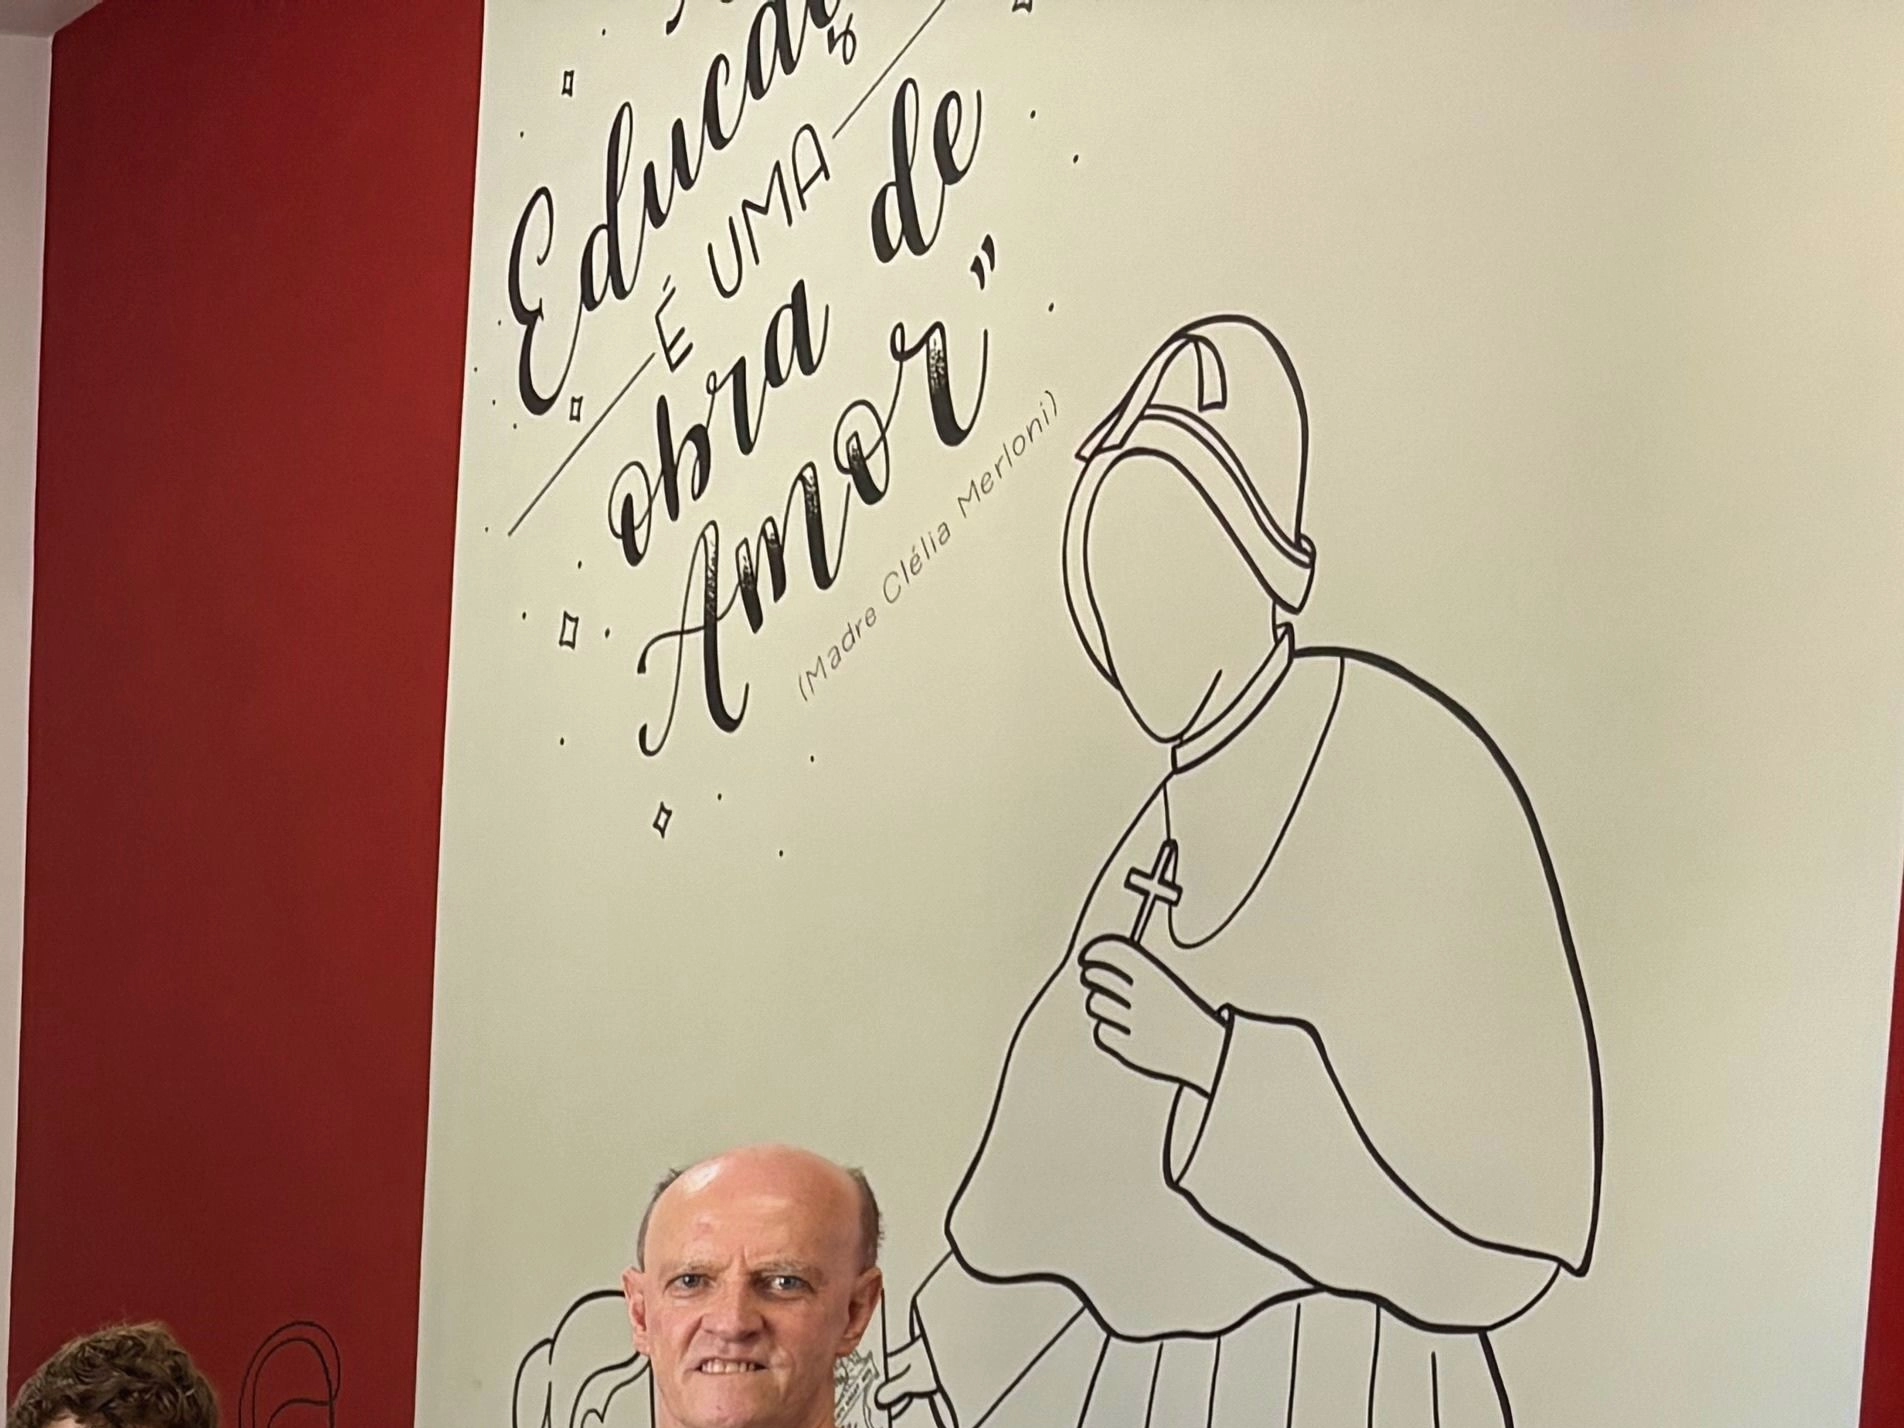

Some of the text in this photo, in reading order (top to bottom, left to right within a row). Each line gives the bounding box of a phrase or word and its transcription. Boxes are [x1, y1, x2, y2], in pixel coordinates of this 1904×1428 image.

[608, 78, 982, 566] obra de
[654, 123, 830, 371] É UMA
[798, 390, 1060, 703] (Madre Clélia Merloni)
